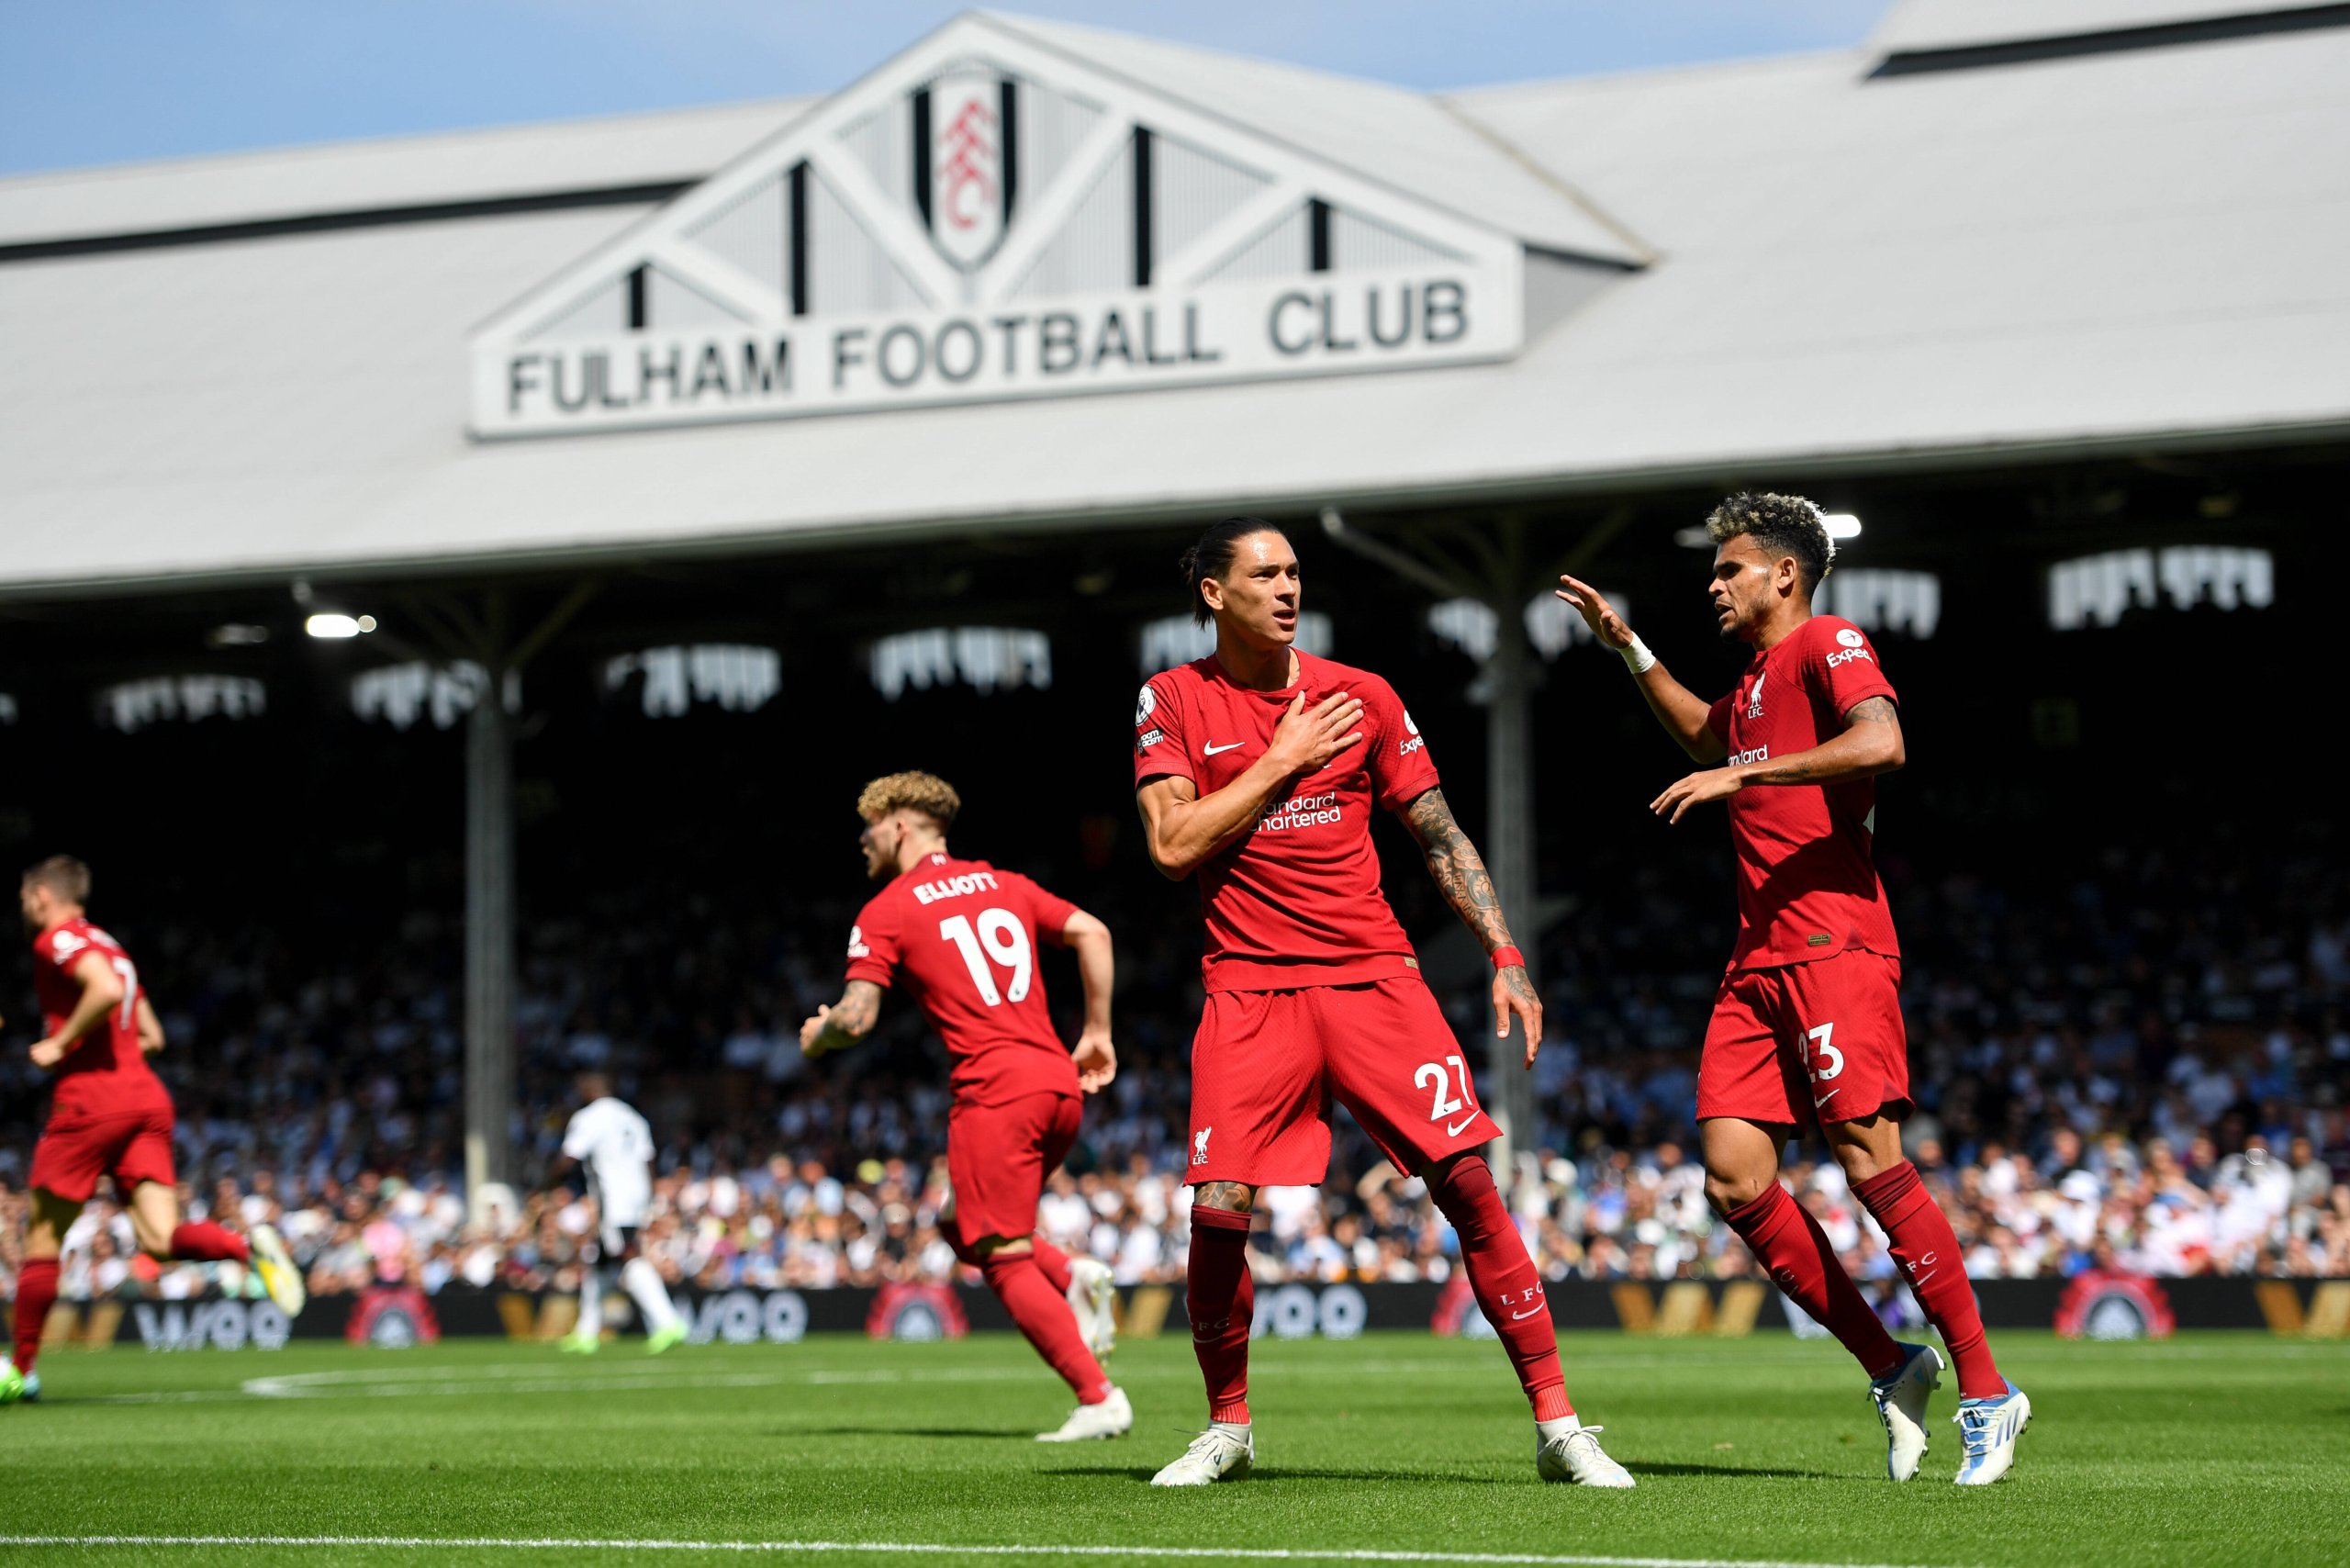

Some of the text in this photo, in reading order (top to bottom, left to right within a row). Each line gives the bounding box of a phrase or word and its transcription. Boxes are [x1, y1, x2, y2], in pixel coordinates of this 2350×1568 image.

[509, 280, 1471, 412] FULHAM FOOTBALL CLUB
[912, 871, 999, 905] ELLIOTT
[939, 907, 1033, 1007] 19
[1798, 1021, 1844, 1083] 23
[1414, 1055, 1473, 1122] 27
